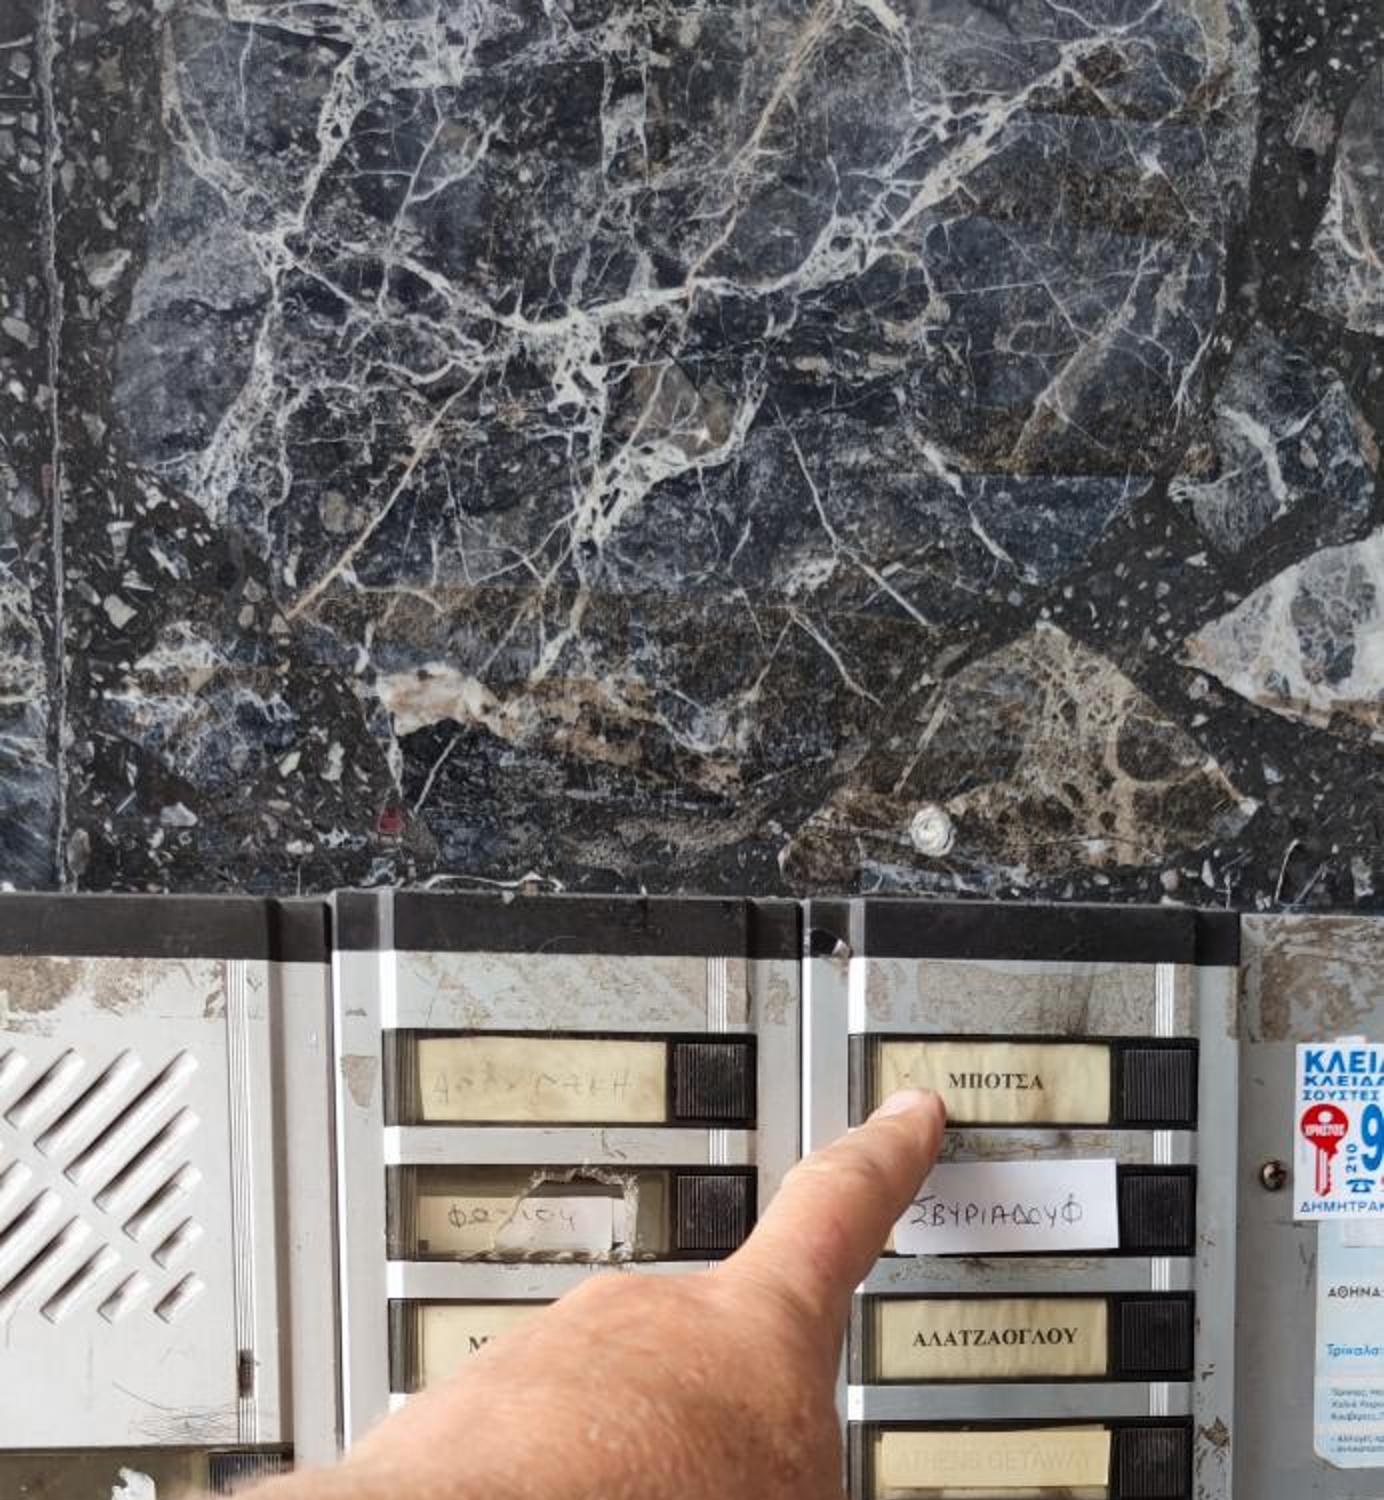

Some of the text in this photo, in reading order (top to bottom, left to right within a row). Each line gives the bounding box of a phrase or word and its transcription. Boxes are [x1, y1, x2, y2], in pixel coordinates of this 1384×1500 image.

[949, 1073, 1044, 1091] ΜΠΟΤΣΑ
[1345, 1144, 1357, 1174] 210
[913, 1327, 1078, 1347] ΑΛΑΤΖΑΟΓΛΟΥ
